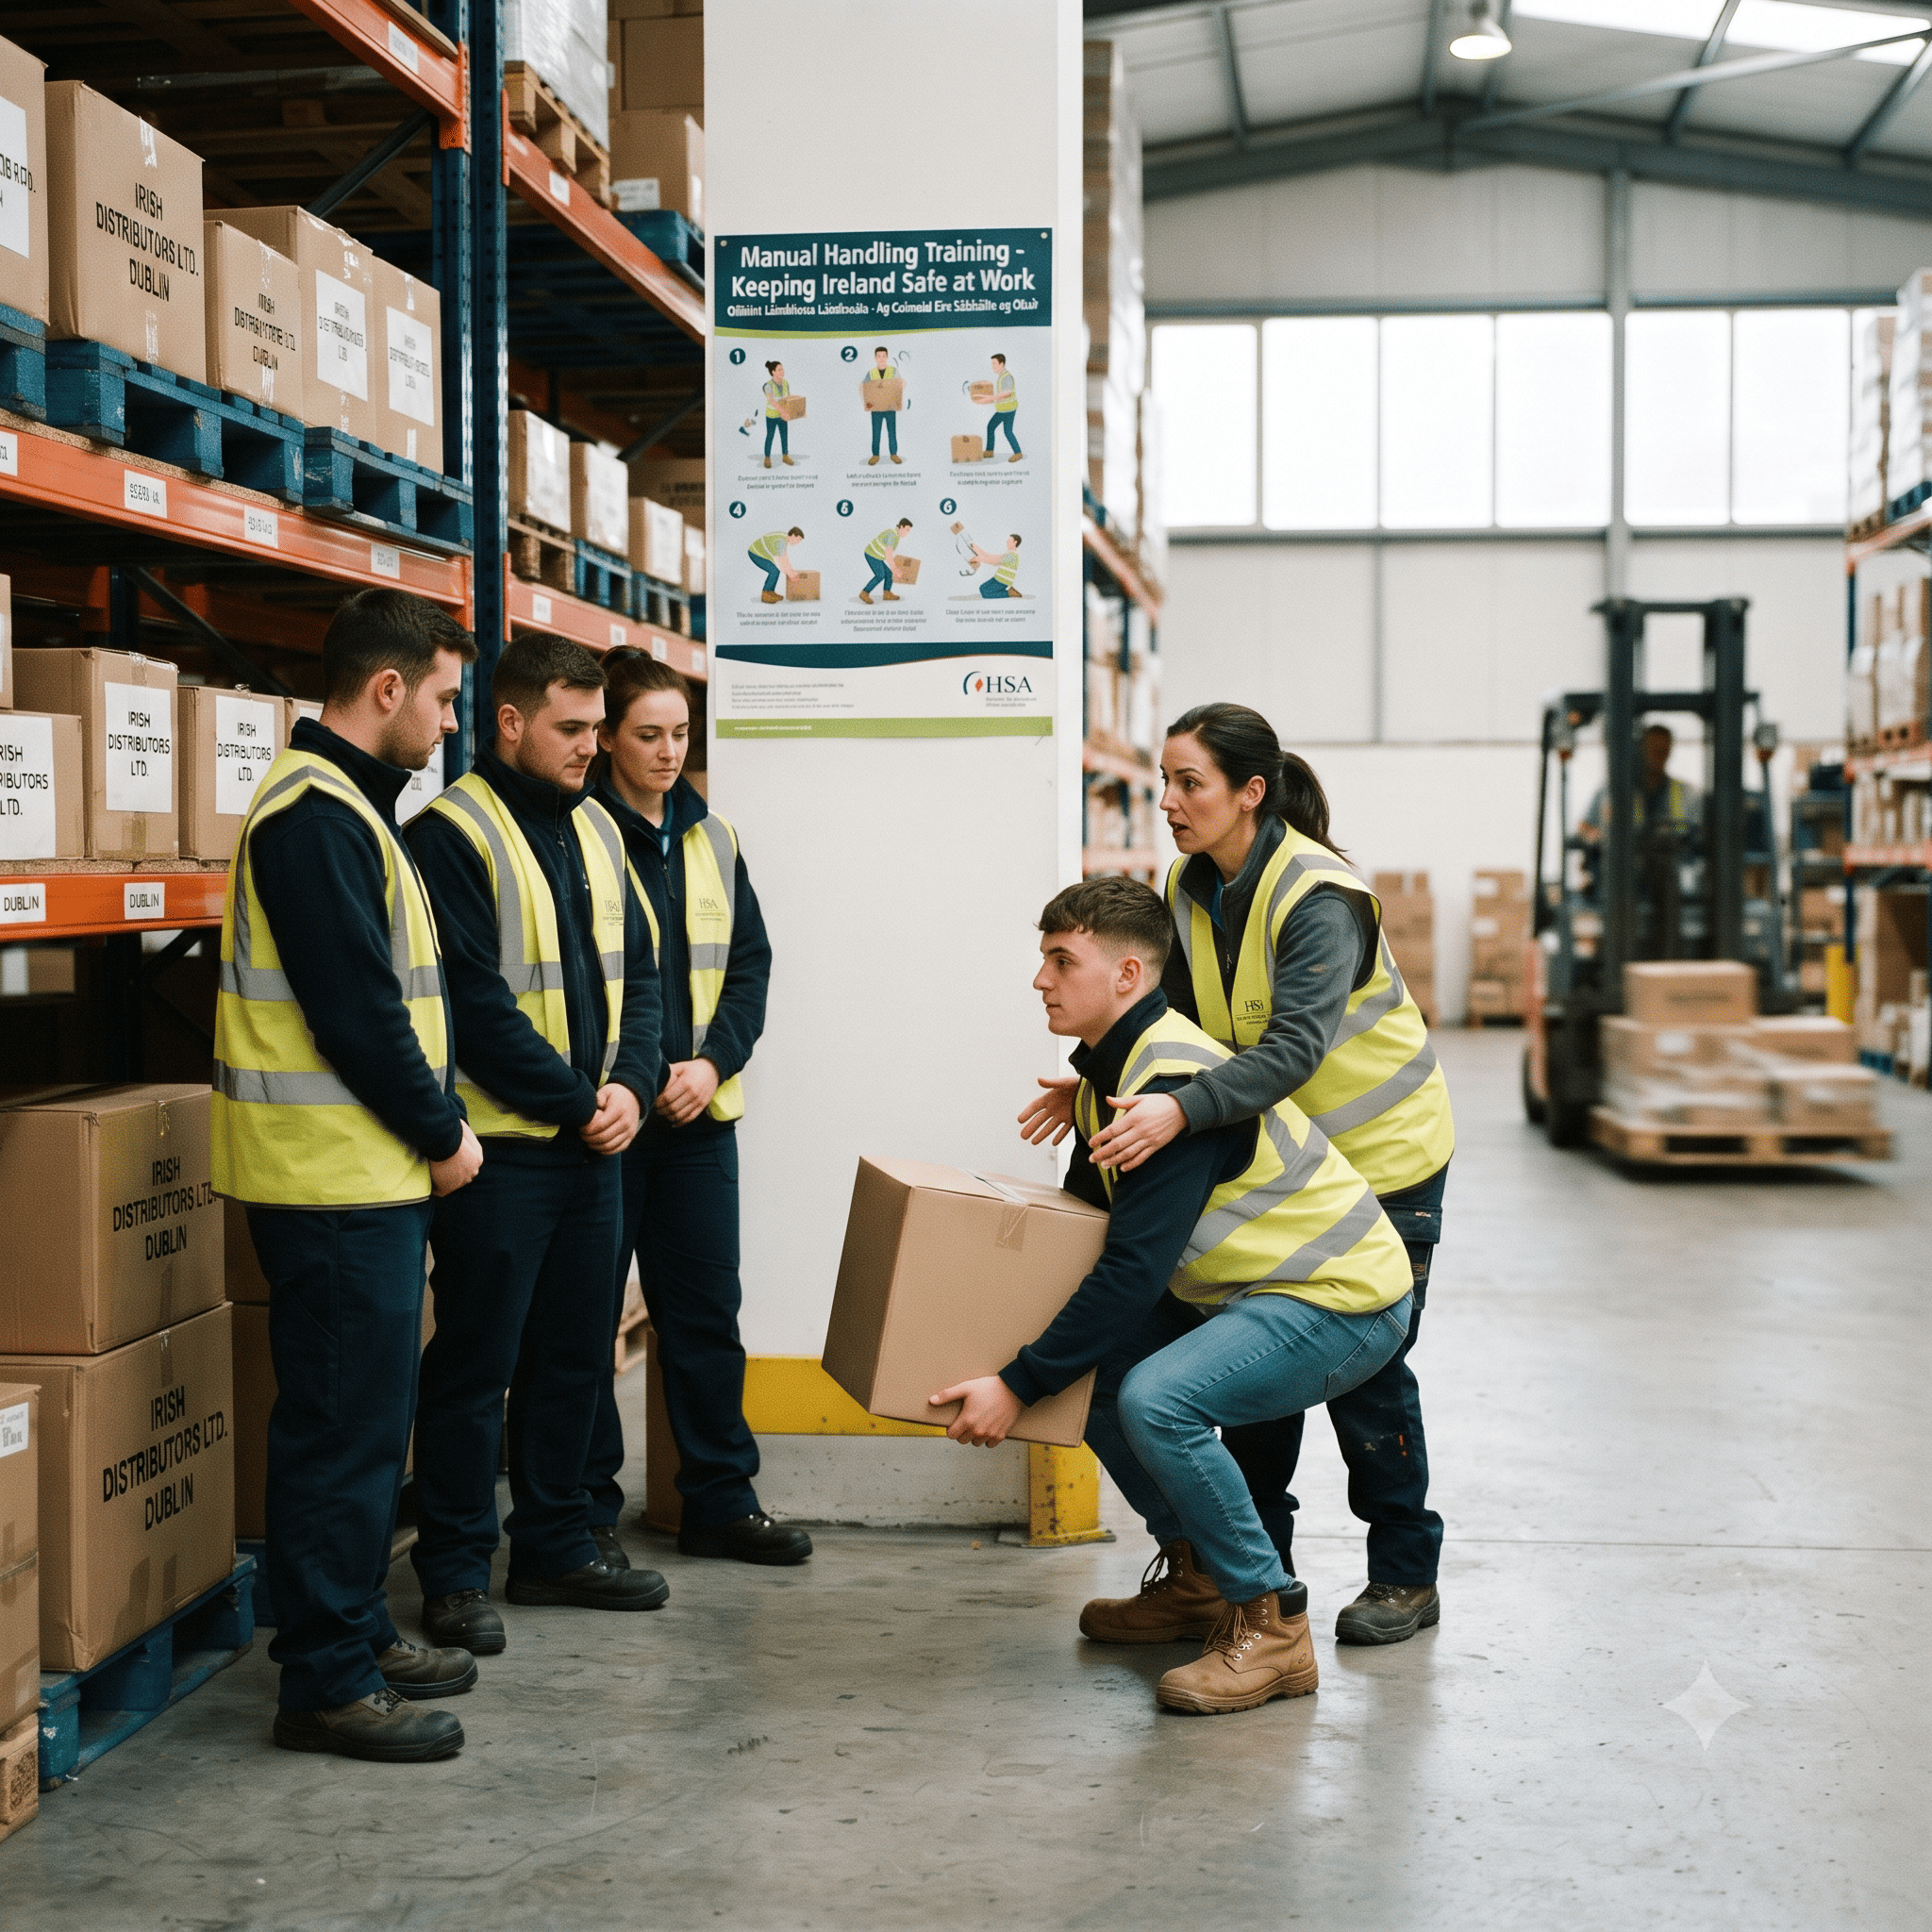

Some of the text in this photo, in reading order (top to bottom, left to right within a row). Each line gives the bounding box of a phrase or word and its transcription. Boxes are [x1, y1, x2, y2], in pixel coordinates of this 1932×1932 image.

[135, 182, 163, 221] IRISH
[96, 201, 199, 276] DISTRIBUTORS LTD.
[741, 242, 818, 268] Manual
[824, 241, 919, 270] Handling
[924, 239, 1010, 267] Training
[129, 258, 170, 302] DUBLIN
[732, 267, 1036, 304] Keeping Ireland Safe at Work
[734, 350, 741, 363] 1
[844, 348, 854, 360] 2
[732, 503, 742, 517] 4
[986, 675, 1032, 693] HSA
[128, 710, 151, 728] IRISH
[108, 733, 171, 755] DISTRIBUTORS
[130, 759, 149, 776] LTD.
[238, 766, 255, 781] LTD.
[0, 798, 24, 815] LTD.
[4, 895, 40, 911] DUBLIN
[129, 893, 159, 908] DUBLIN
[152, 1156, 181, 1186] IRISH
[113, 1186, 194, 1232] DISTRIBUTORS
[145, 1224, 187, 1260] DUBLIN
[151, 1385, 186, 1432] IRISH
[103, 1411, 228, 1503] DISTRIBUTORS LTD.
[145, 1473, 193, 1532] DUBLIN
